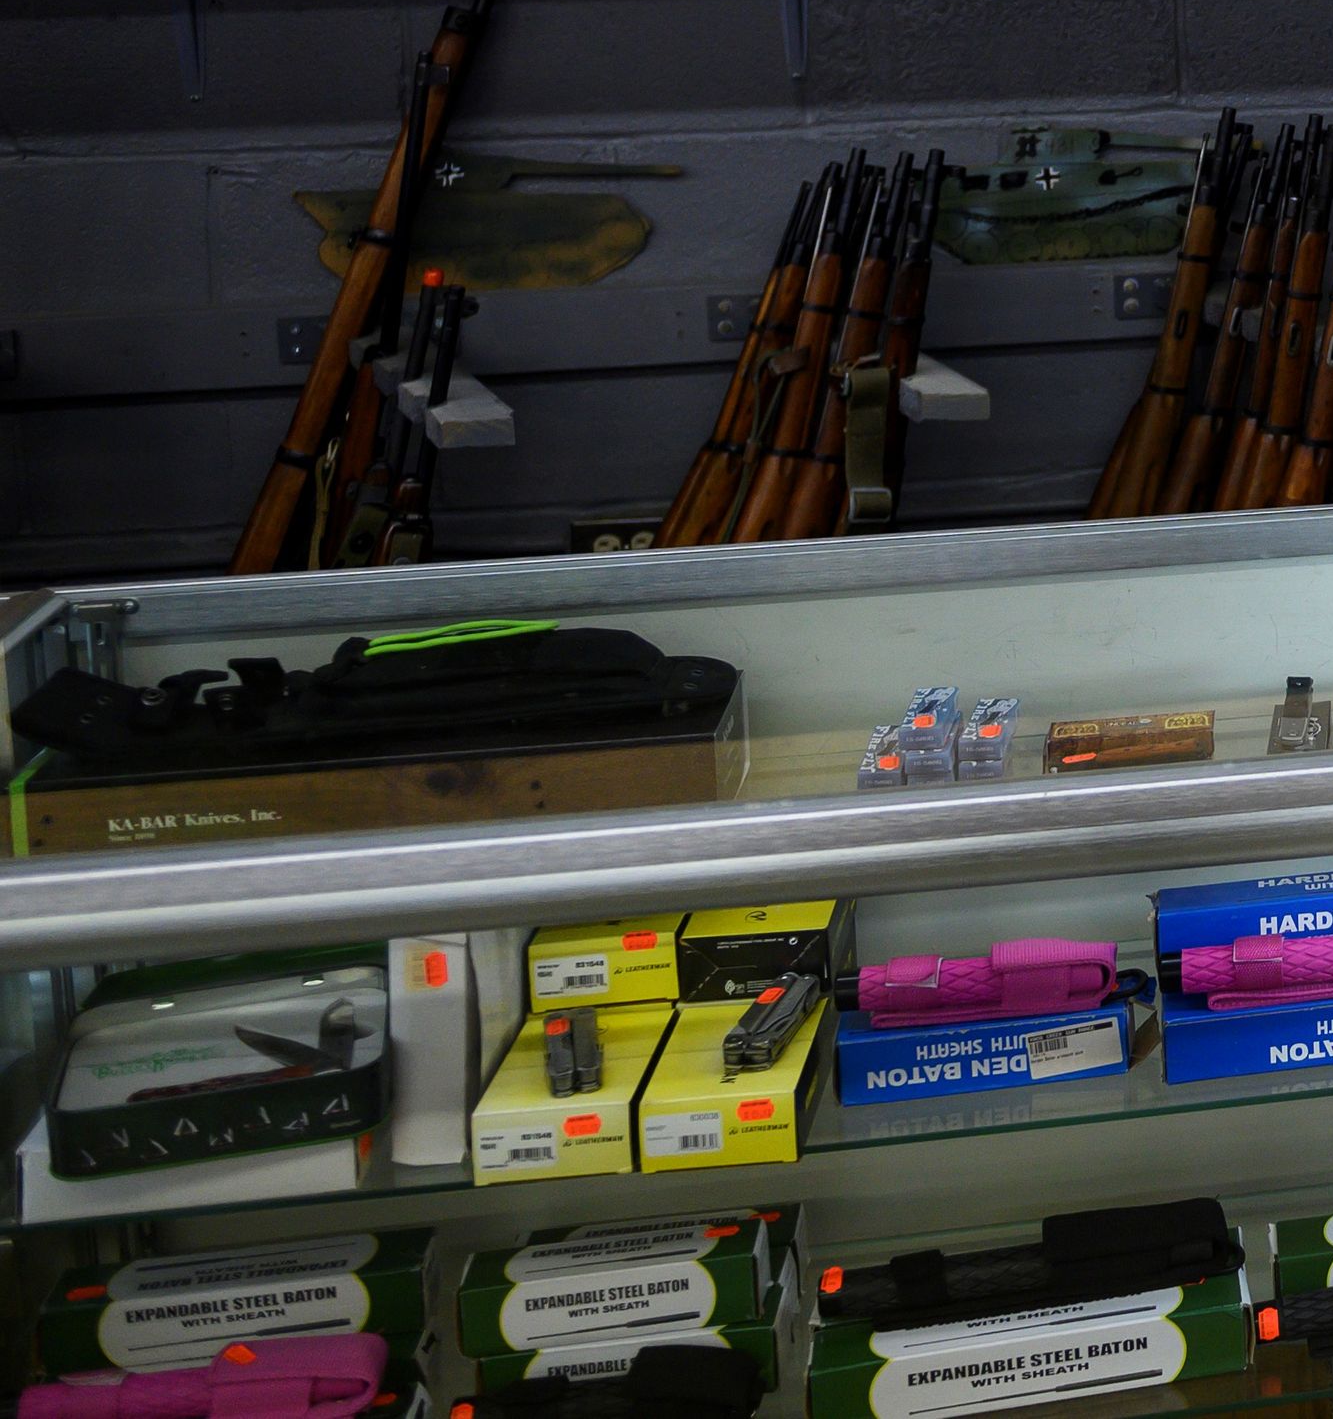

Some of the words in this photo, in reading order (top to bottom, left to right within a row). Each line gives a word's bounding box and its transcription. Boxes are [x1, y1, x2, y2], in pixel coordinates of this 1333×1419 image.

[962, 723, 978, 741] FLY
[861, 754, 877, 774] FLY
[108, 814, 177, 832] KA-BAR
[250, 808, 283, 822] Inc.
[624, 961, 672, 974] LEATHERMAN
[916, 1039, 983, 1061] SHEATH
[867, 1061, 962, 1090] BATON
[741, 1122, 791, 1136] LEATHERMAN
[575, 1135, 625, 1147] LEATHERMAN
[531, 1241, 610, 1259] EXPANDABLE
[612, 1237, 649, 1249] STEEL
[651, 1232, 695, 1244] BATON
[125, 1302, 230, 1324] EXPANDABLE
[233, 1293, 280, 1311] STEEL
[283, 1286, 338, 1304] BATON
[525, 1289, 606, 1313] EXPANDABLE
[608, 1283, 646, 1301] STEEL
[647, 1278, 690, 1296] BATON
[180, 1316, 222, 1329] WITH
[225, 1308, 287, 1323] SHEATH
[568, 1307, 600, 1319] WITH
[602, 1299, 651, 1314] SHEATH
[966, 1314, 1012, 1329] WITH
[1016, 1304, 1085, 1321] SHEATH
[547, 1358, 627, 1378] EXPANDABLE
[908, 1355, 1026, 1387] EXPANDABLE
[1030, 1347, 1084, 1368] STEEL
[1087, 1337, 1149, 1358] BATON
[970, 1373, 1016, 1389] WITH
[1021, 1361, 1090, 1380] SHEATH
